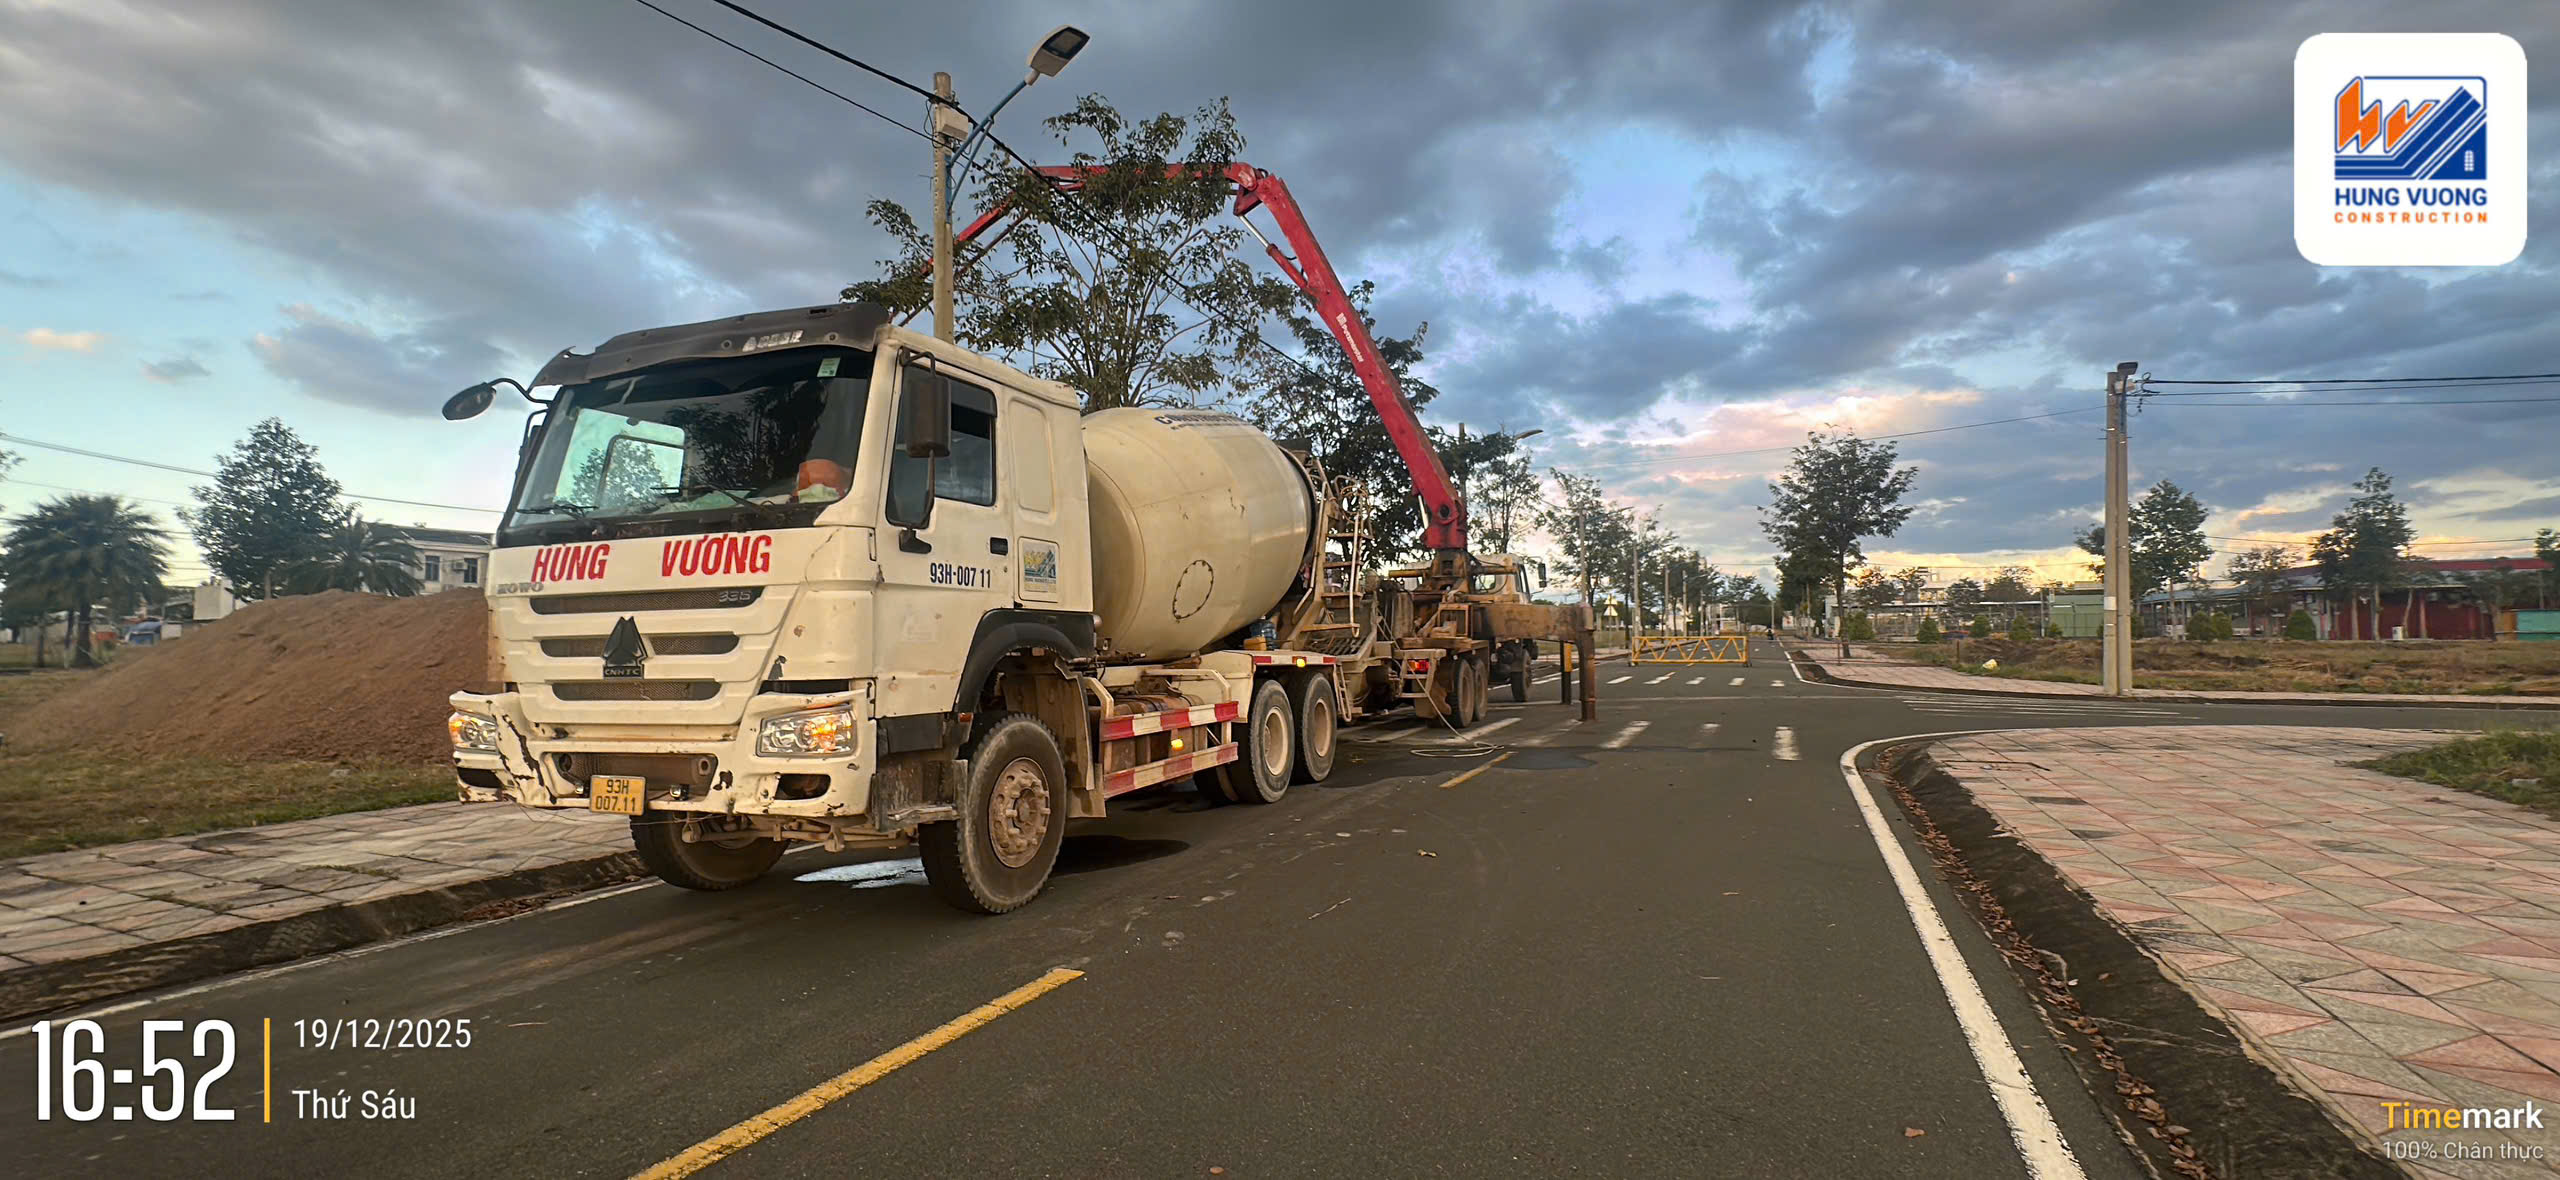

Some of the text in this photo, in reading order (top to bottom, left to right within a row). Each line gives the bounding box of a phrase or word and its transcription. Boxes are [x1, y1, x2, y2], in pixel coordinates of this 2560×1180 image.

[661, 534, 772, 577] VƯƠNG
[606, 779, 630, 794] 93H
[595, 795, 636, 812] 007.11
